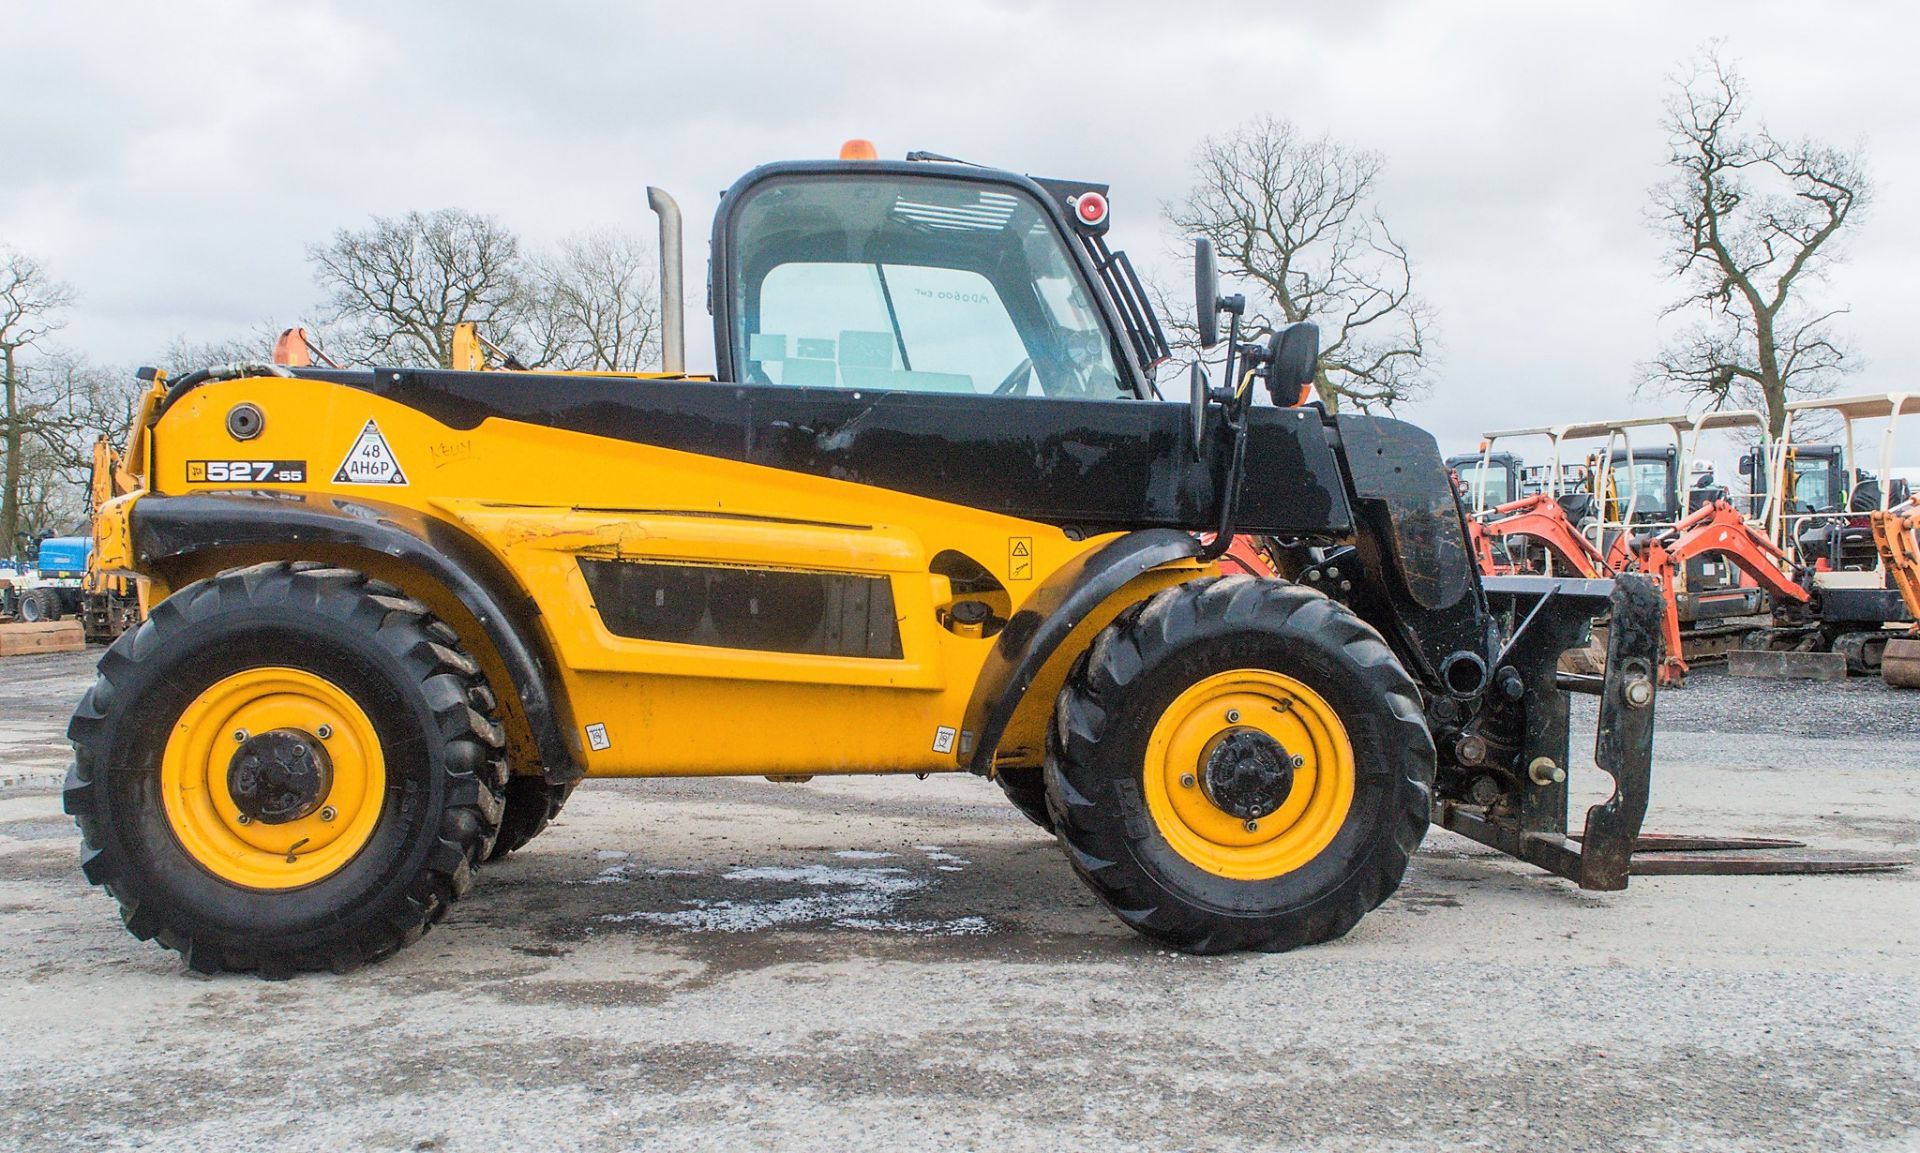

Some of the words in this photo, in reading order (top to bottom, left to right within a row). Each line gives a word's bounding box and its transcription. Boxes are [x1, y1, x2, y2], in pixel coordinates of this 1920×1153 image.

[362, 444, 380, 458] 48
[207, 462, 302, 481] 527-55
[350, 460, 389, 475] AH6P
